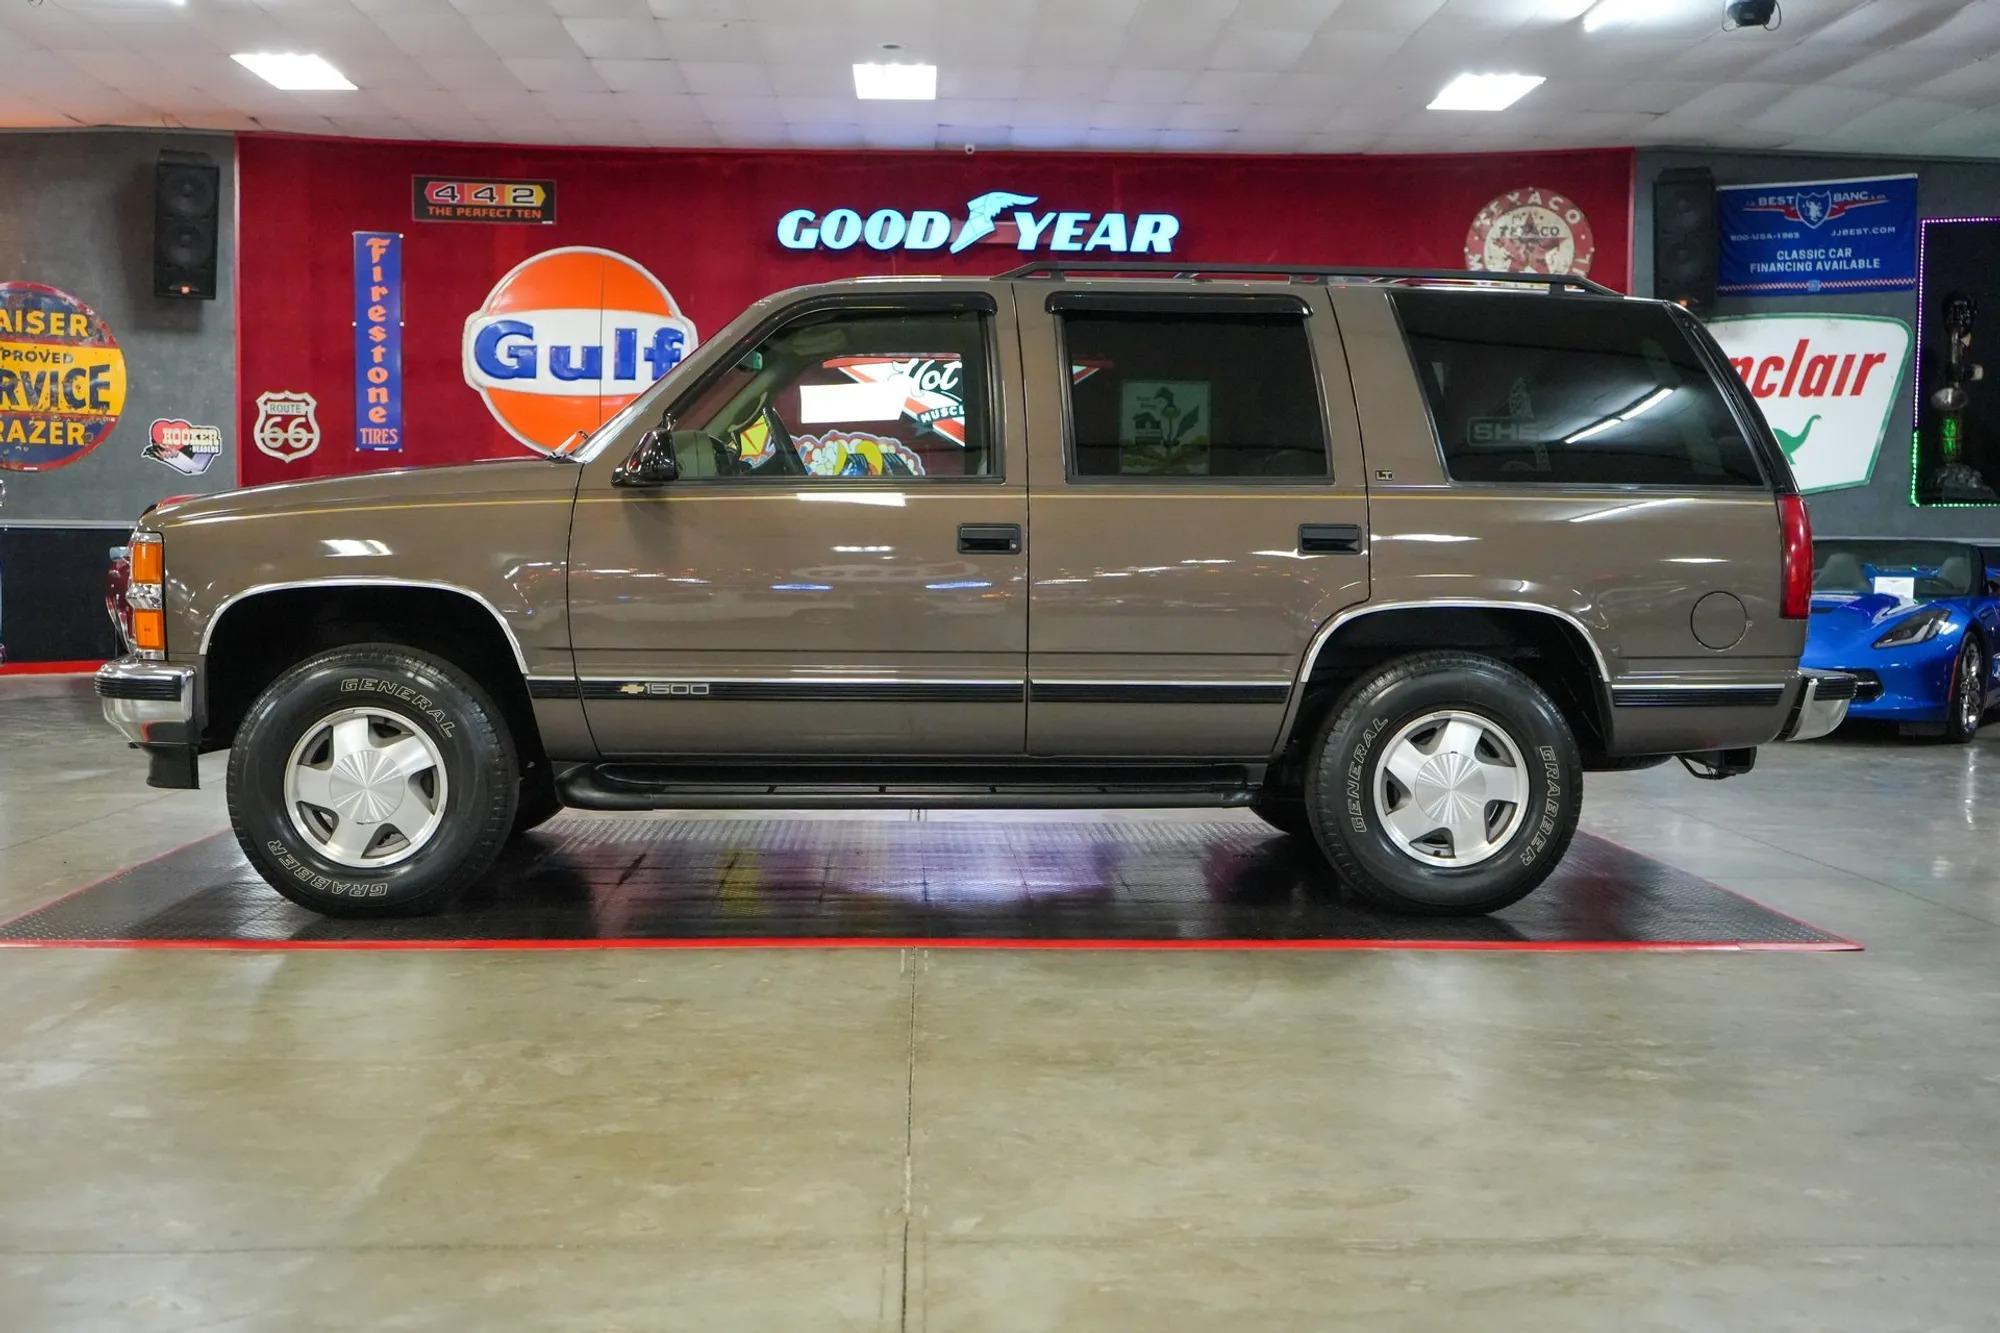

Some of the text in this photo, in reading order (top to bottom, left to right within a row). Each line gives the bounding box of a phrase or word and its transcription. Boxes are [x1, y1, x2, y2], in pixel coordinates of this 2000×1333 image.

[433, 184, 537, 205] 442
[1758, 195, 1794, 206] BEST
[1834, 191, 1868, 202] BANC
[427, 206, 541, 218] THE PERFECT TEN
[776, 208, 1180, 253] GOOD YEAR
[1832, 226, 1896, 236] JJBEST.COM
[1777, 248, 1852, 260] CLASSIC CAR
[1750, 258, 1880, 273] FINANCING AVAILABLE
[366, 237, 391, 424] Firestone
[474, 319, 685, 381] Gulf
[269, 403, 301, 414] ROUTE
[0, 418, 86, 446] AZER
[162, 427, 219, 447] HOOKER
[263, 417, 308, 449] 66
[360, 428, 397, 444] TIRES
[1376, 470, 1393, 481] LT
[645, 683, 710, 695] 1500
[340, 678, 455, 738] GENERAL
[1347, 717, 1389, 833] GENERAL
[1520, 745, 1561, 866] GRABBER
[267, 838, 388, 896] GRABBER
